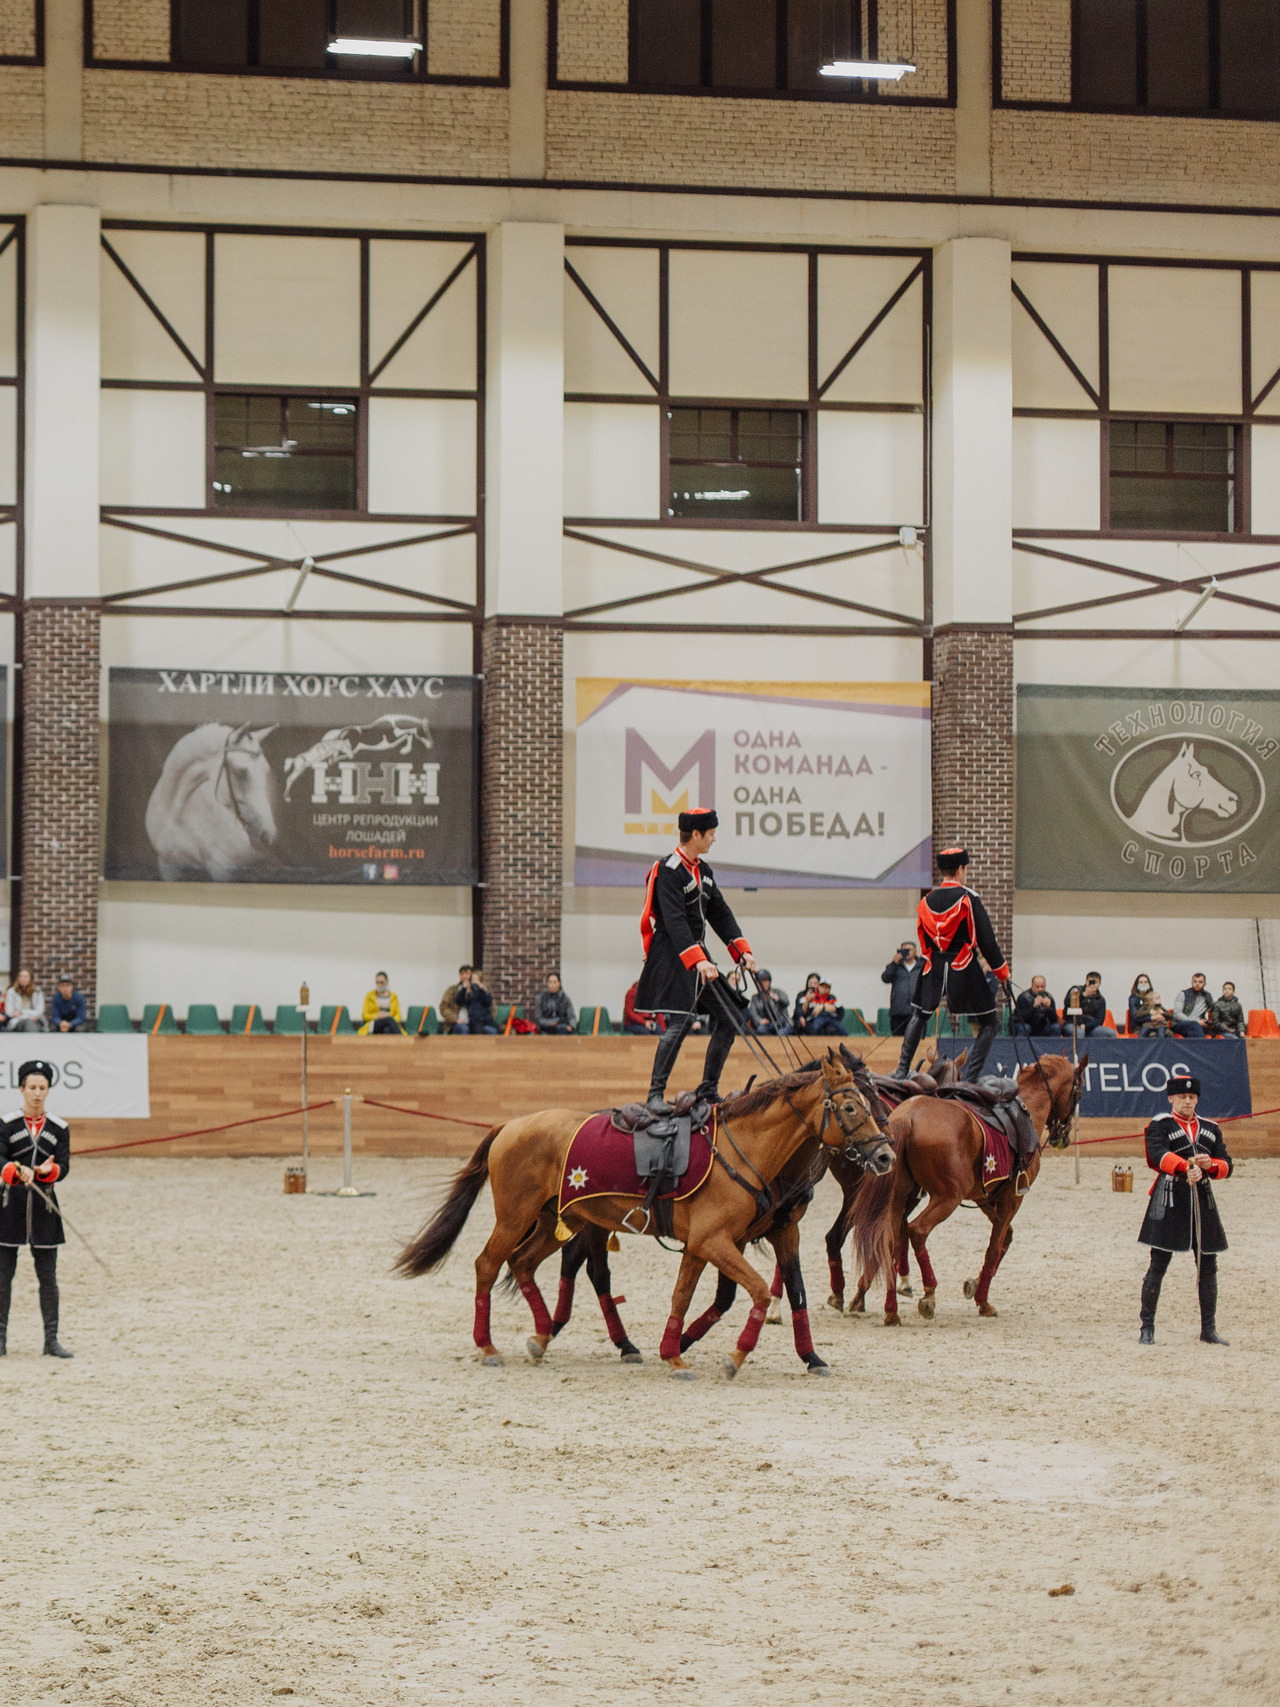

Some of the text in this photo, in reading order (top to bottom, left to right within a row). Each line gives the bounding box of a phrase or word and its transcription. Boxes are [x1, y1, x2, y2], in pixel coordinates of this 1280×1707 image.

[158, 671, 444, 699] ХАРТЛИ ХОРС ХАУС
[733, 729, 802, 750] ОДНА
[1094, 701, 1280, 760] ТЕХНОЛОГИЯ
[734, 753, 874, 777] КОМАНДА
[733, 785, 802, 806] ОДНА
[312, 813, 439, 827] ЦЕНТР РЕПРОДУКЦИИ
[735, 811, 886, 839] ПОБЕДА!
[345, 830, 407, 843] ЛОШАДЕЙ
[329, 845, 425, 860] horsefarm.ru
[1121, 840, 1257, 880] СПОРТА
